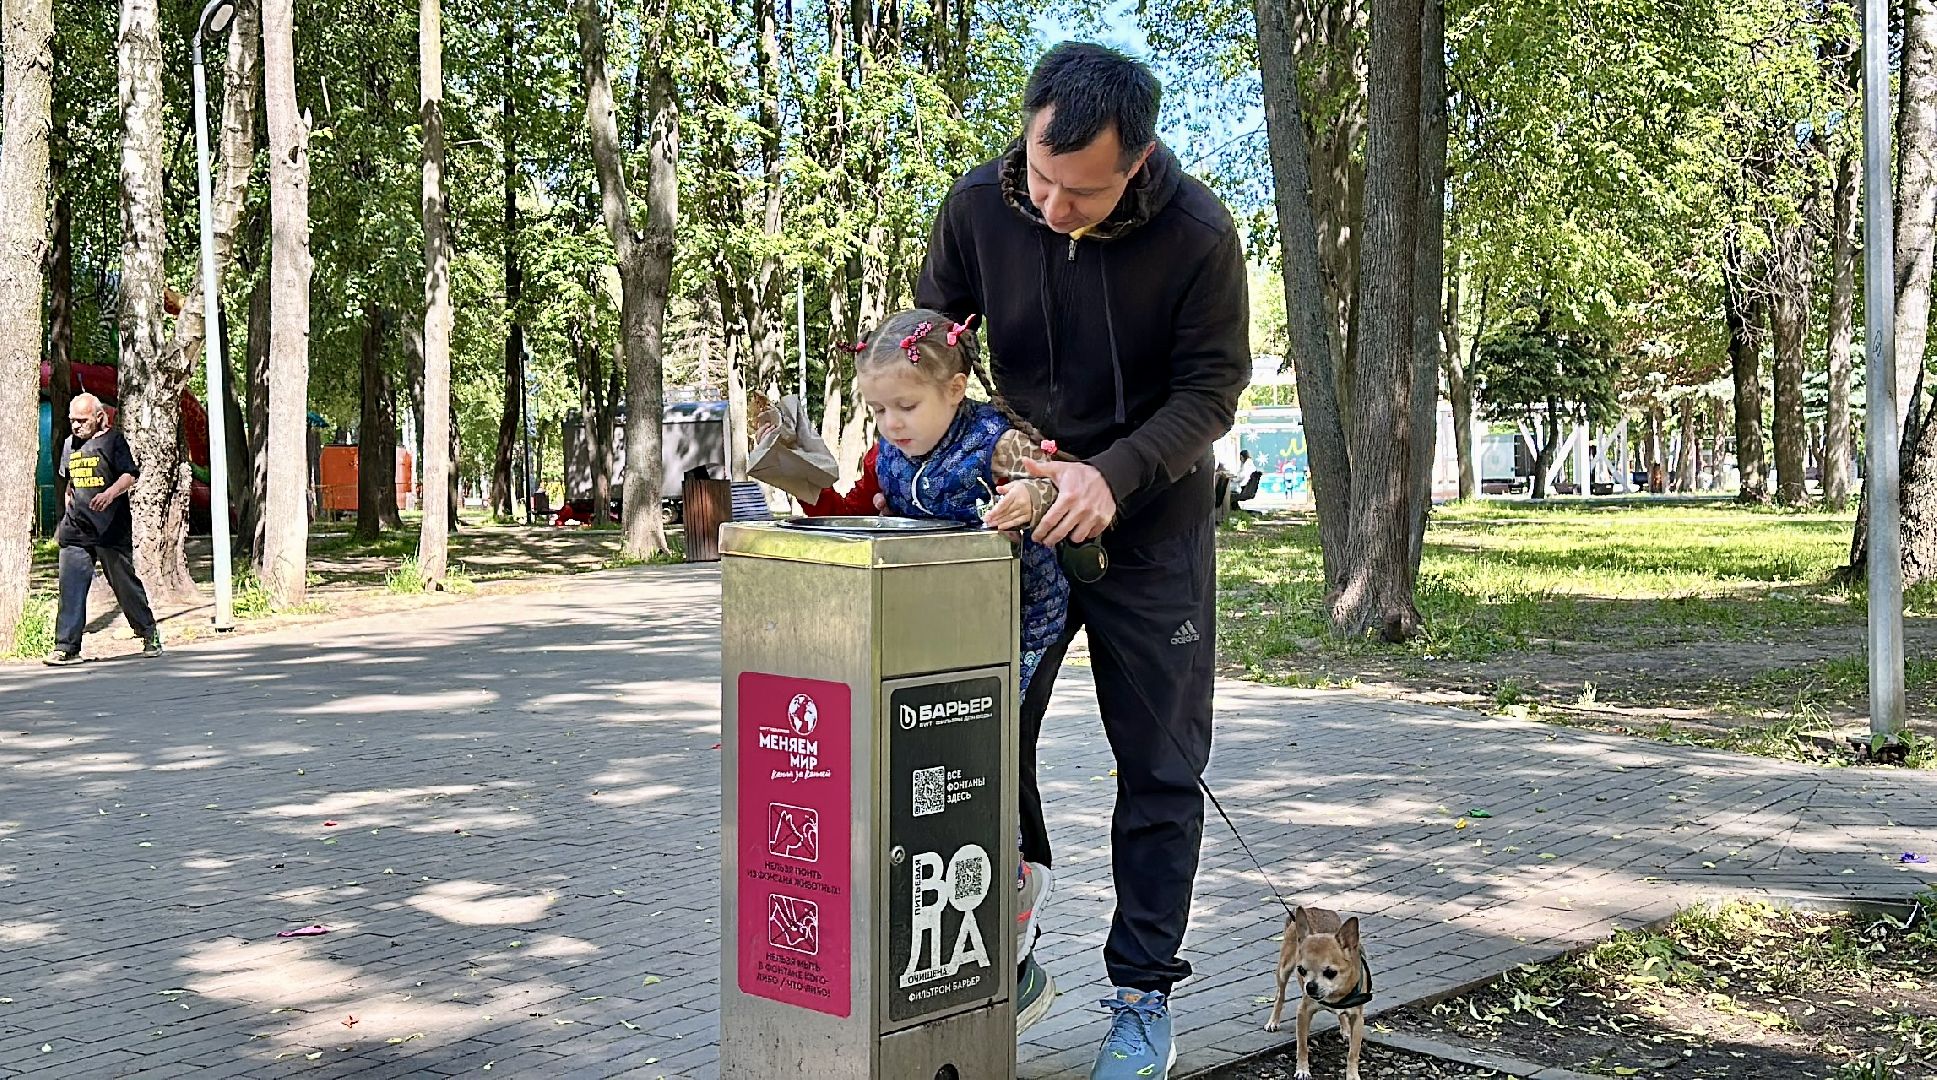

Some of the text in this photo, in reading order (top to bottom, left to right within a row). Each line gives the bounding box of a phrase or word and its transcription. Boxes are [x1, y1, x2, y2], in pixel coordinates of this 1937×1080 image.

[1170, 633, 1200, 645] adidas
[919, 696, 993, 721] БАРЬЕР
[759, 732, 818, 755] МЕНЯЕМ
[790, 753, 818, 771] МИР
[947, 770, 962, 781] ВСЕ
[947, 777, 985, 792] ФОНТАНЫ
[947, 791, 972, 804] ЗДЕСЬ
[914, 859, 922, 916] ПИТЬЕВАЯ
[907, 966, 949, 984] ОЧИЩЕНА
[952, 975, 981, 991] БАРЬЕР
